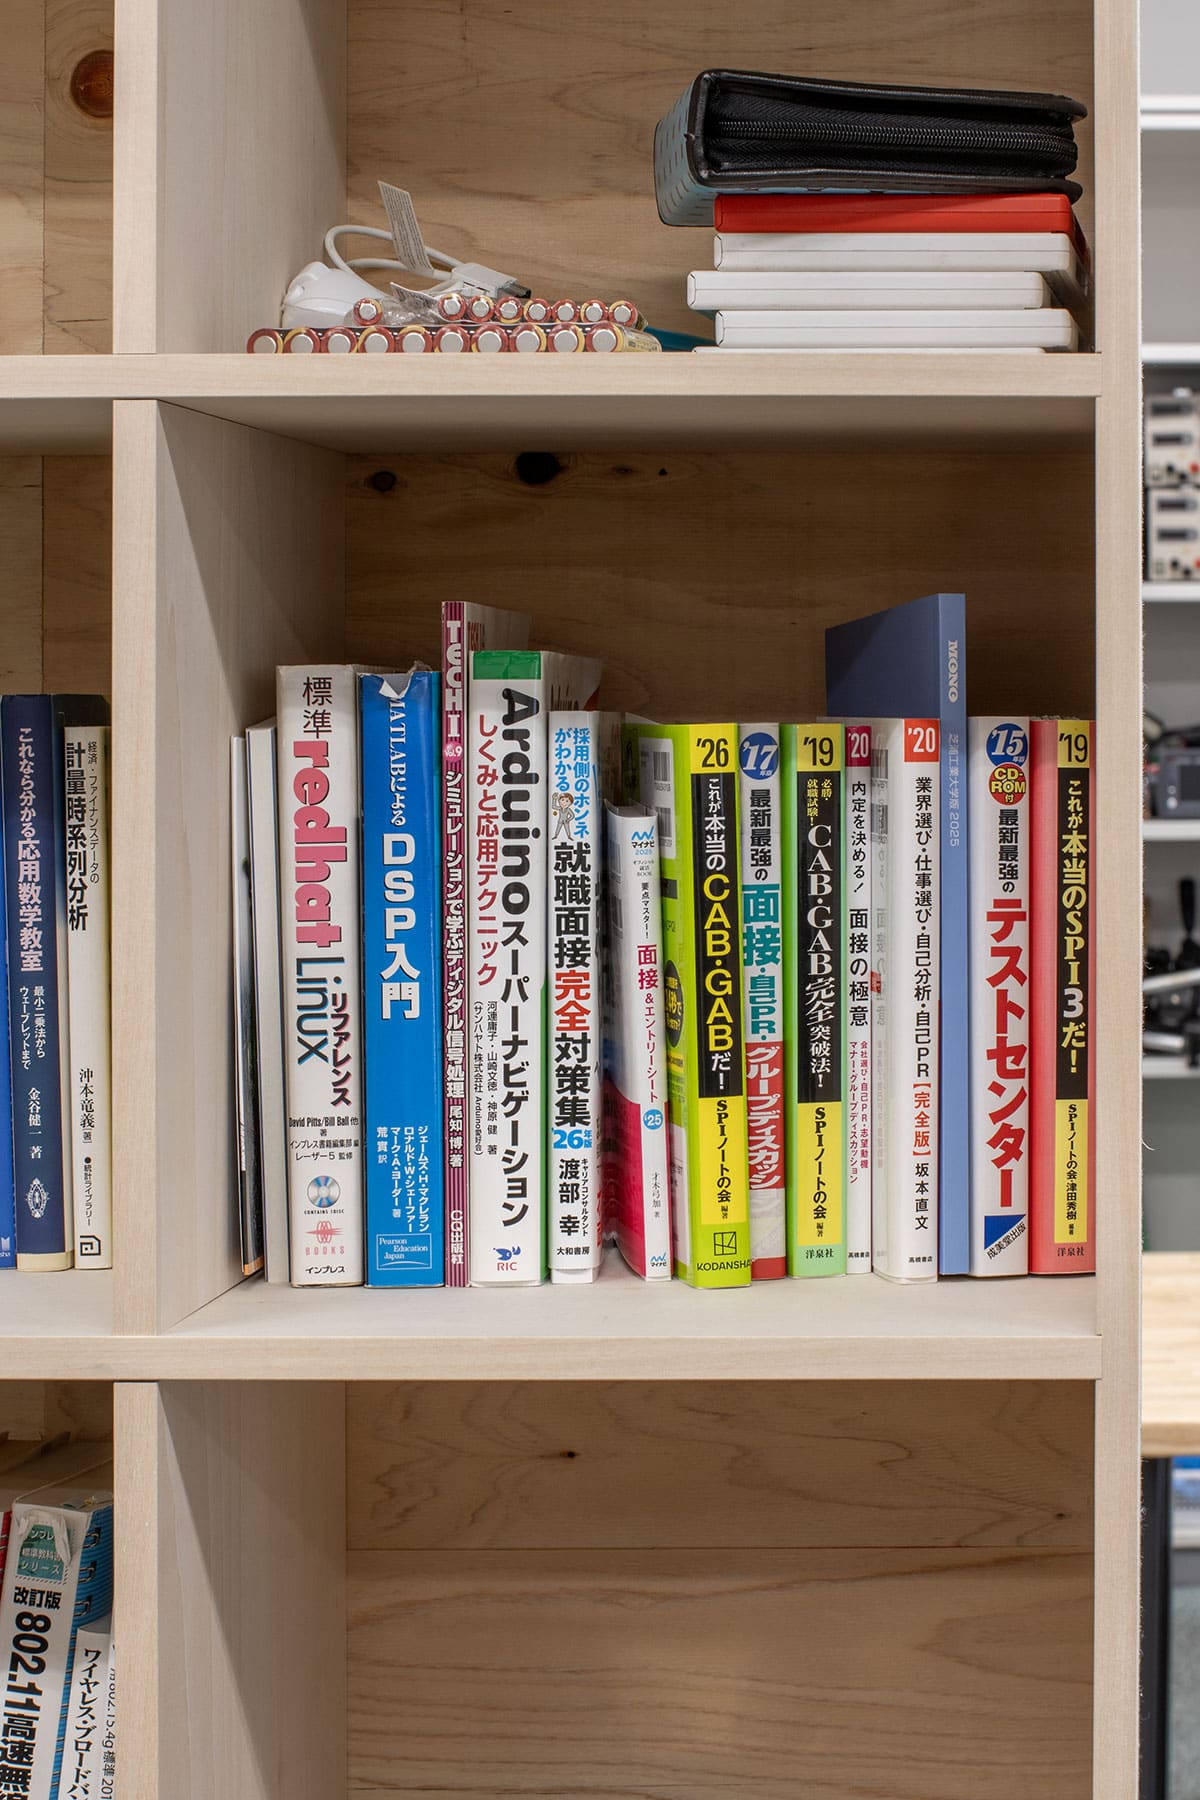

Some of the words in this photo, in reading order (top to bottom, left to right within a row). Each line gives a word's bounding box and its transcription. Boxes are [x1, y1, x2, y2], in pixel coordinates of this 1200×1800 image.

[948, 640, 958, 703] MONO
[302, 676, 332, 738] 標準
[554, 728, 571, 791] がわかる
[573, 728, 590, 836] 採用側のホンネ
[991, 781, 1026, 793] ROM
[66, 742, 88, 931] 計量時系列分析
[88, 742, 99, 884] 経済・ファイナンスデータの
[750, 789, 772, 881] 最新最強の
[950, 812, 959, 847] 2025
[18, 727, 44, 971] これなら分かる応用数学教室
[476, 714, 499, 986] しくみと応用テクニック
[998, 809, 1019, 893] 最新最強の
[381, 833, 420, 1020] DSP入門
[445, 770, 467, 1098] シミュレーションで学ぶディジタル信号処理
[501, 688, 540, 1227] Arduinoスーパーナビゲーション
[552, 842, 592, 1127] 就職面接完全対策集
[849, 909, 868, 1026] 面接の極意
[19, 986, 31, 1070] ウェーブレットまで
[33, 986, 46, 1059] 最小二乗法から
[295, 956, 345, 1066] Linux
[330, 992, 352, 1107] リファレンス
[986, 899, 1028, 1207] テストセンター
[27, 1087, 42, 1135] 金谷健一
[30, 1146, 42, 1159] 著
[296, 1152, 335, 1160] レーザー5
[404, 1126, 415, 1233] ロナルド・W・シェーファー
[418, 1125, 429, 1232] ジェームズ・H・マクレラン
[559, 1159, 580, 1204] 渡部
[716, 1100, 731, 1203] SPIノートの会
[813, 1107, 827, 1219] SPIノートの会
[560, 1215, 580, 1236] 幸
[581, 1158, 589, 1237] キャリアコンサルタント
[915, 1163, 929, 1230] 坂本直文
[305, 1246, 345, 1255] BOOKS
[305, 1265, 345, 1274] インプレス
[384, 1252, 405, 1261] Japan
[451, 1210, 464, 1264] CQ出版社
[496, 1262, 517, 1271] RIC
[557, 1246, 590, 1255] 大和書房
[696, 1259, 752, 1271] KODANSHA
[805, 1248, 834, 1259] 洋泉社
[986, 1222, 1026, 1260] 成美堂出版
[1057, 1247, 1085, 1257] 洋泉社
[14, 1586, 62, 1609] 改訂版
